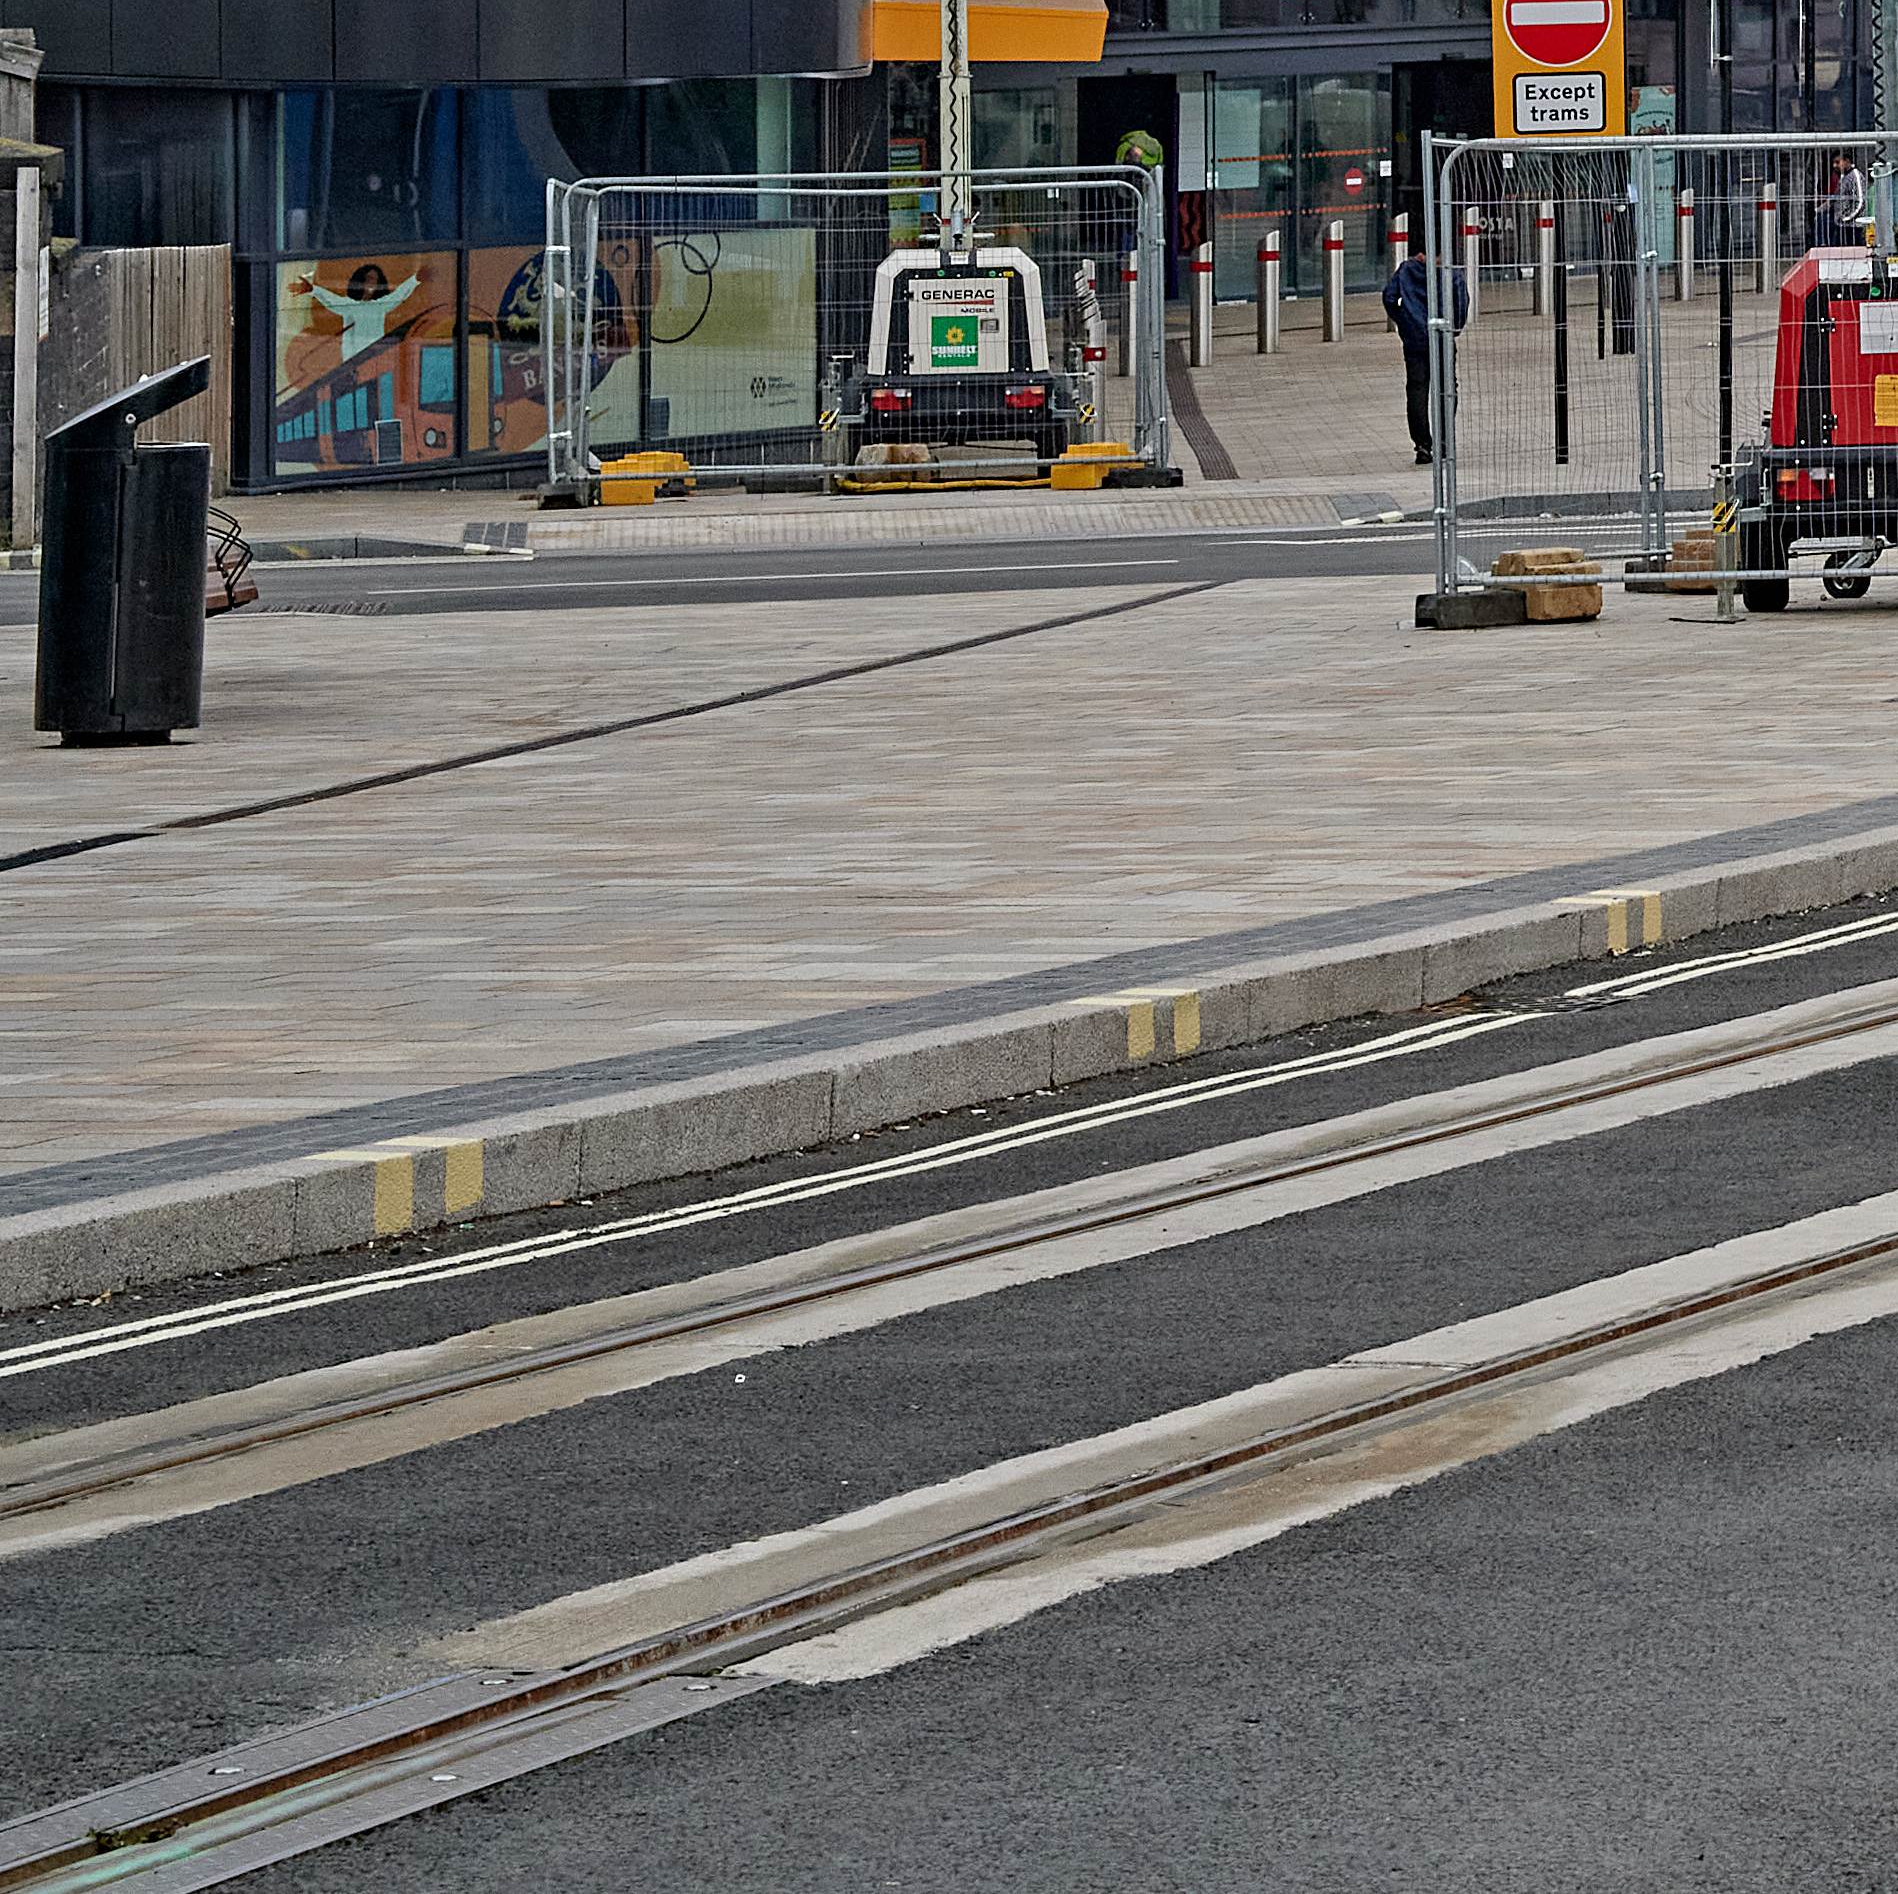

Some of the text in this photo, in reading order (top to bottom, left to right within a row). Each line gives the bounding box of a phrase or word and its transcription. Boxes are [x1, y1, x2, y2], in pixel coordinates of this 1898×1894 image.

[1525, 82, 1596, 102] Except
[1530, 106, 1590, 122] trams
[1478, 216, 1514, 232] OSTA
[921, 289, 995, 300] GENERAC
